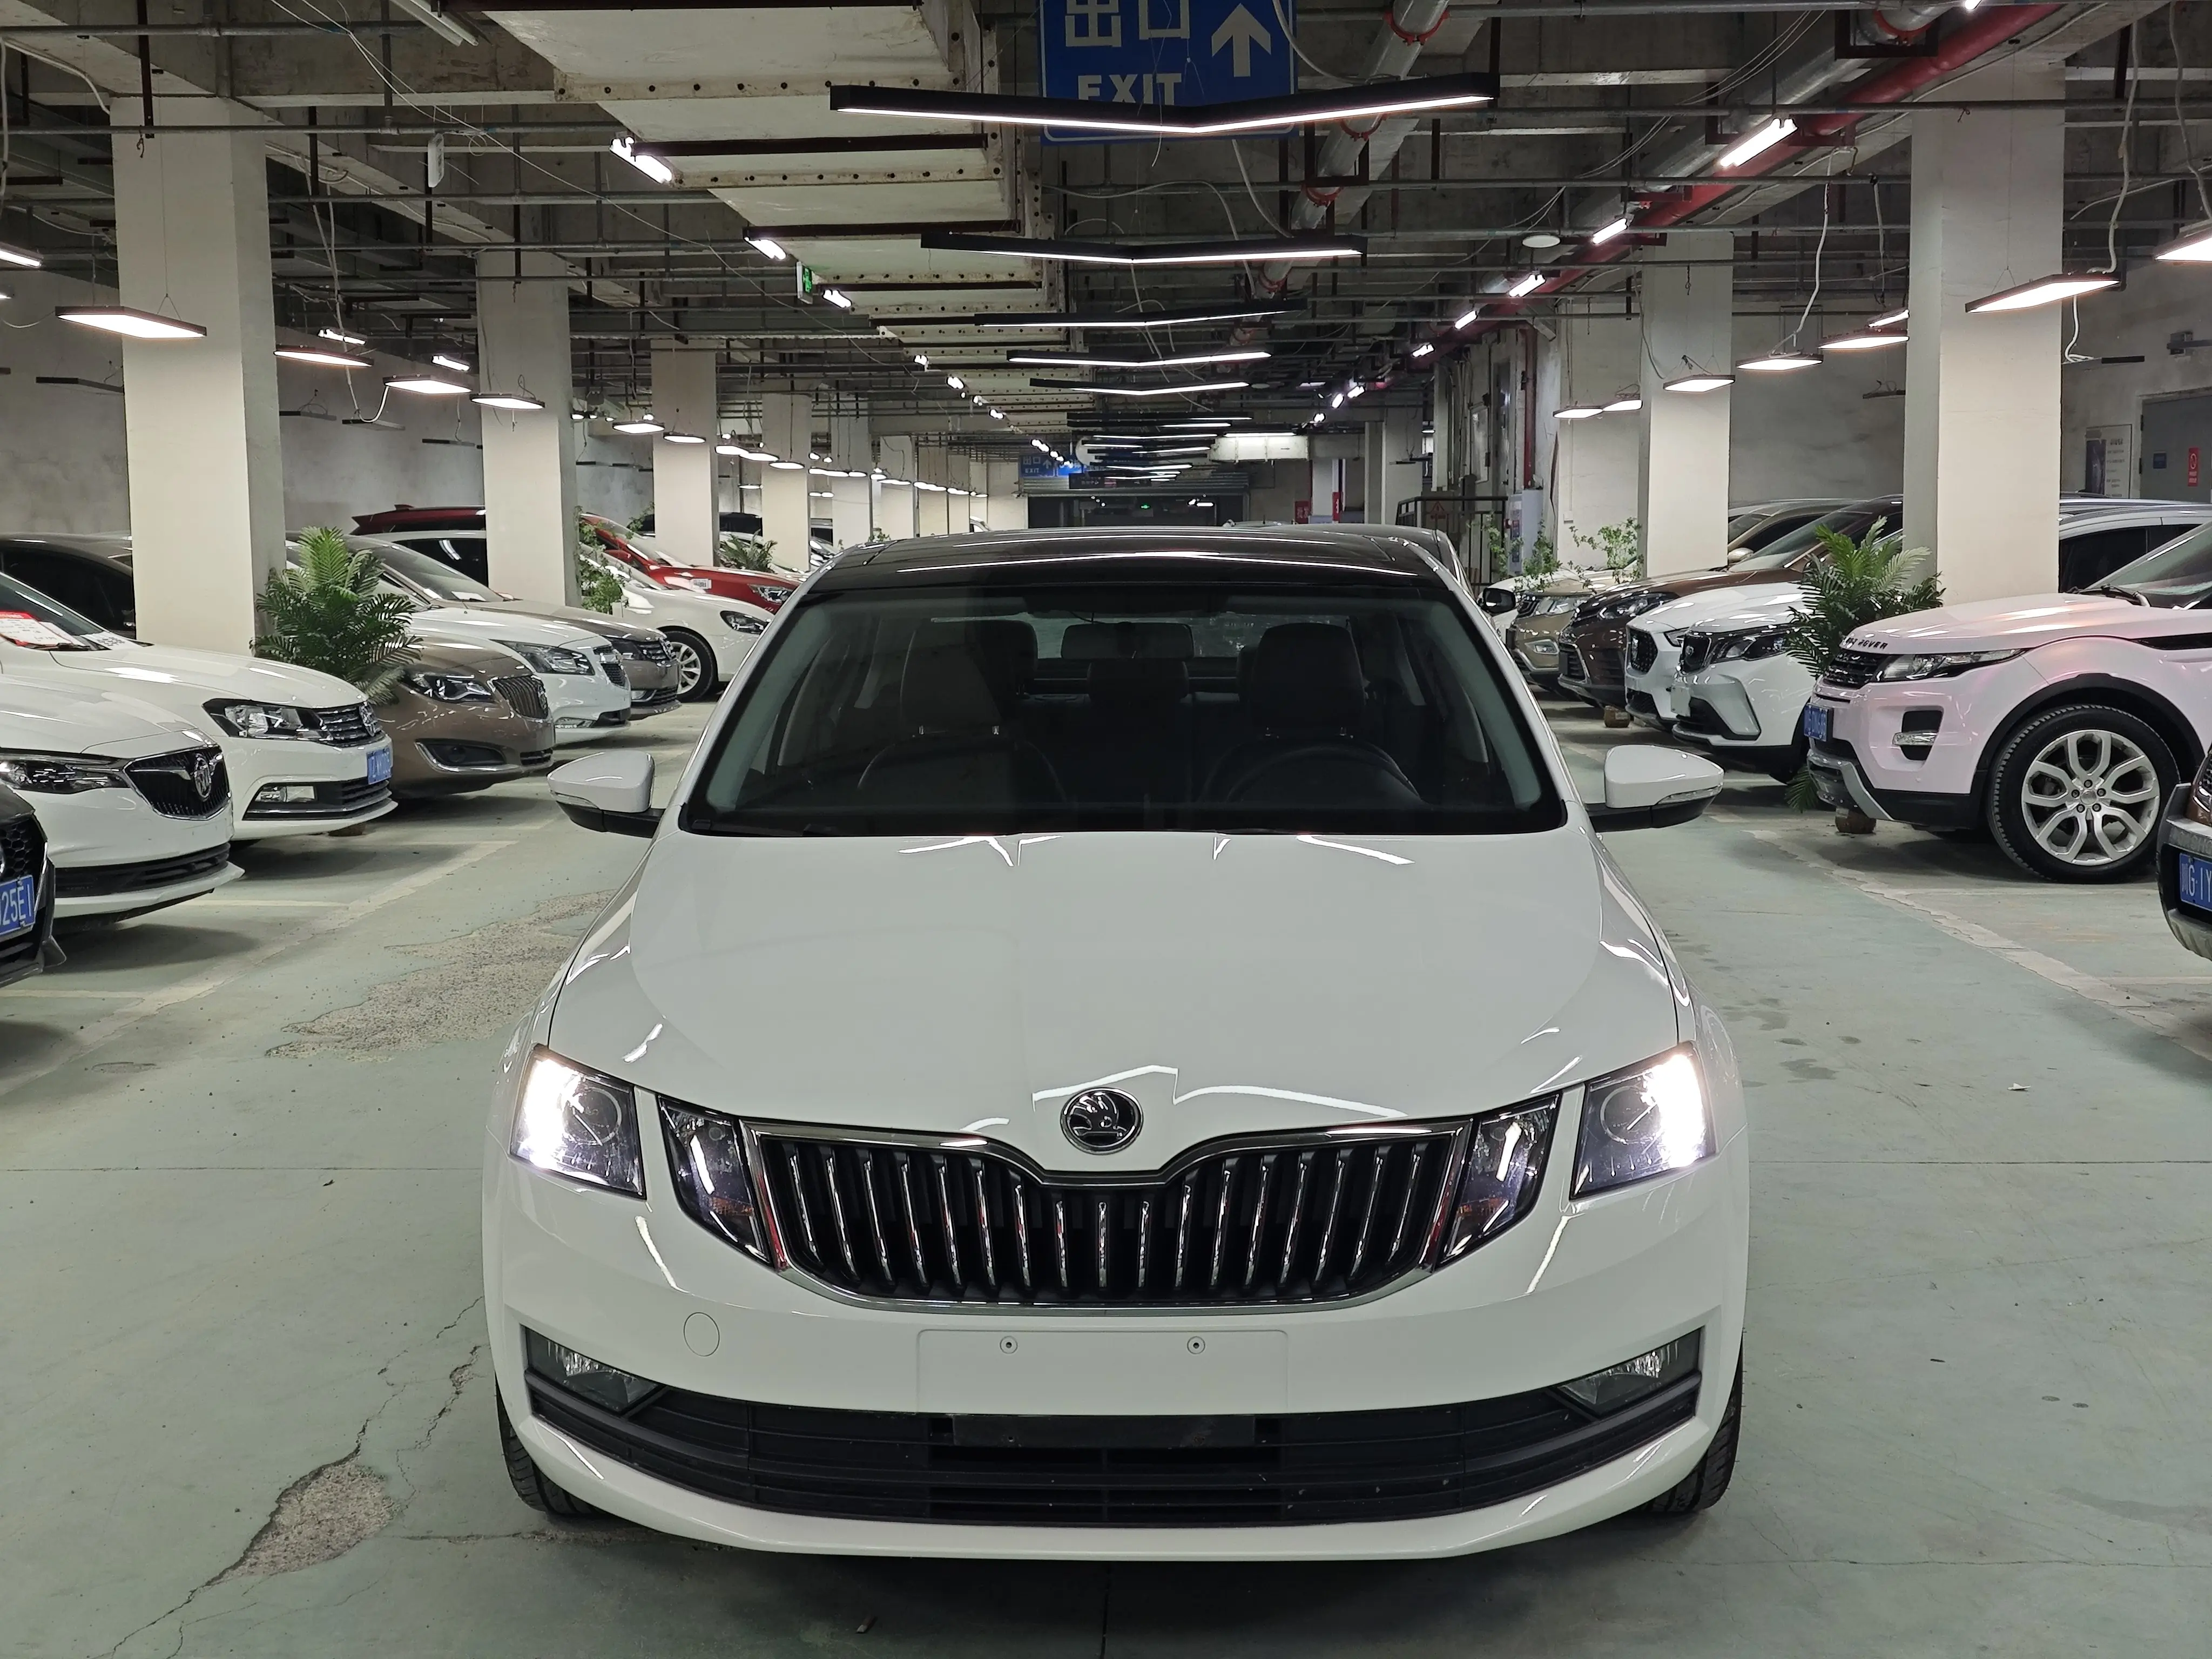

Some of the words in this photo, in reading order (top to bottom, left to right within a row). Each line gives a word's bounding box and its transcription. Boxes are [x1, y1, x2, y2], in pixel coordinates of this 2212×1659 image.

[1065, 0, 1190, 47] 出口
[1078, 73, 1182, 105] EXIT
[1023, 456, 1041, 465] 出口
